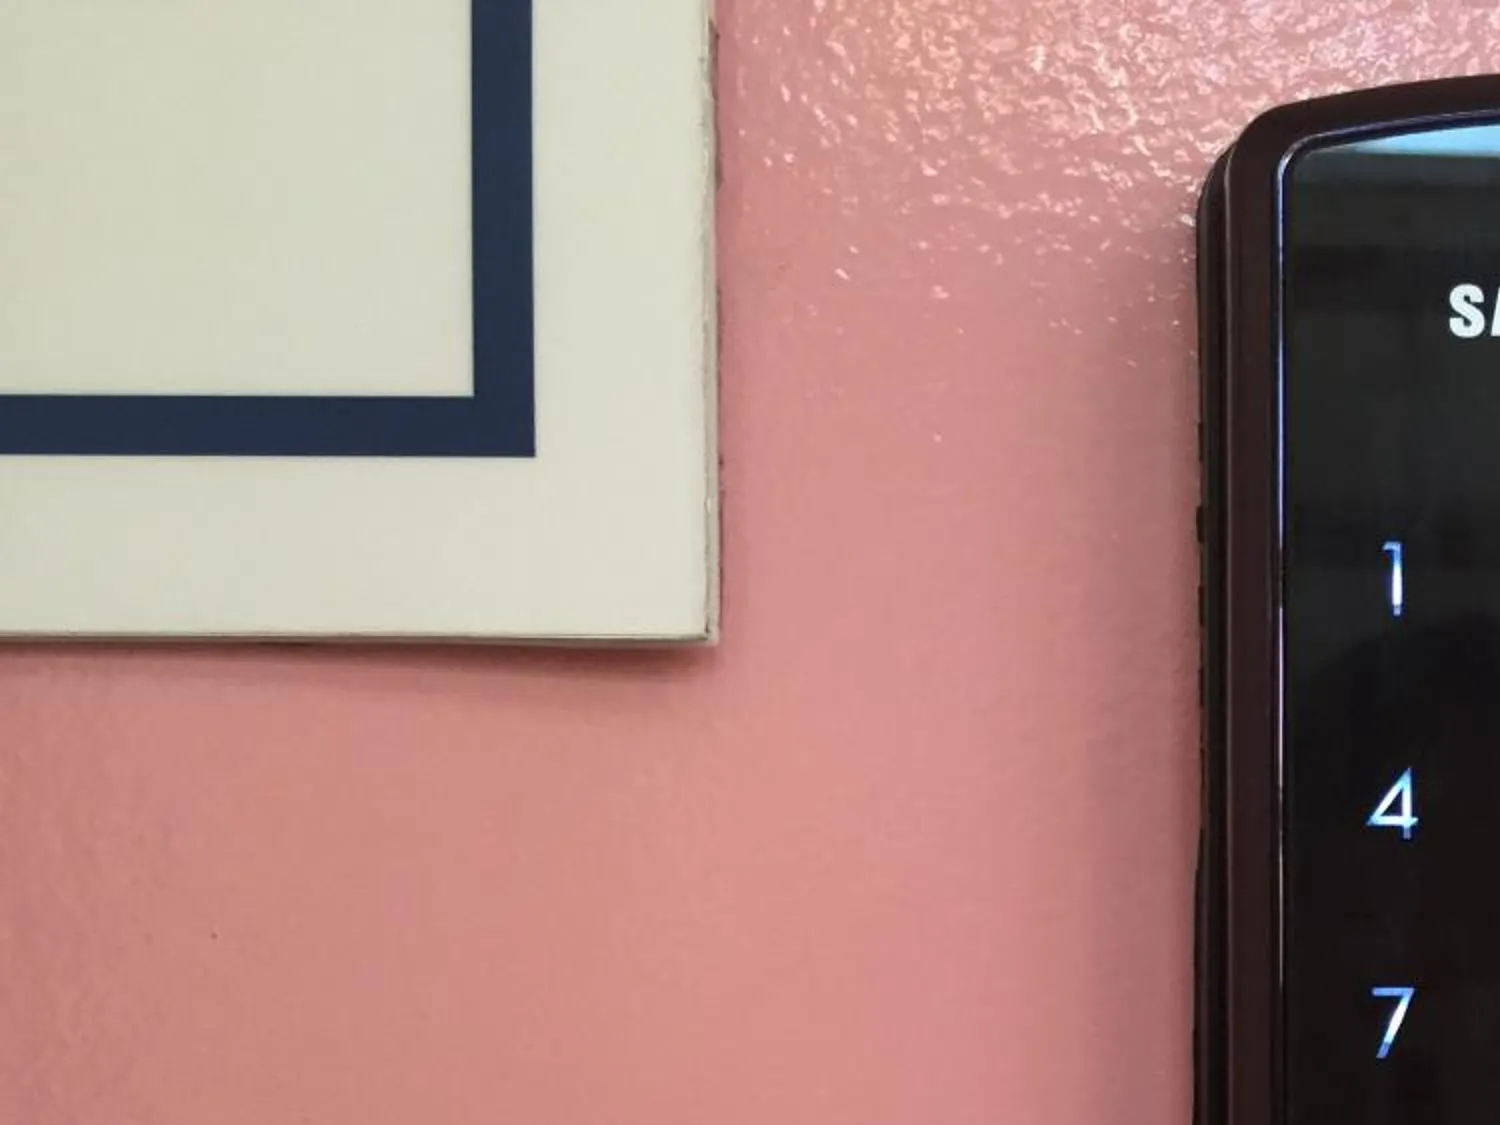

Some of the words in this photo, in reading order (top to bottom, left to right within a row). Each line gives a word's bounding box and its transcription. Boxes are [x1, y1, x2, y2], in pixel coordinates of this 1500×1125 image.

[1382, 541, 1405, 616] 1
[1367, 768, 1419, 840] 4
[1372, 987, 1415, 1059] 7
